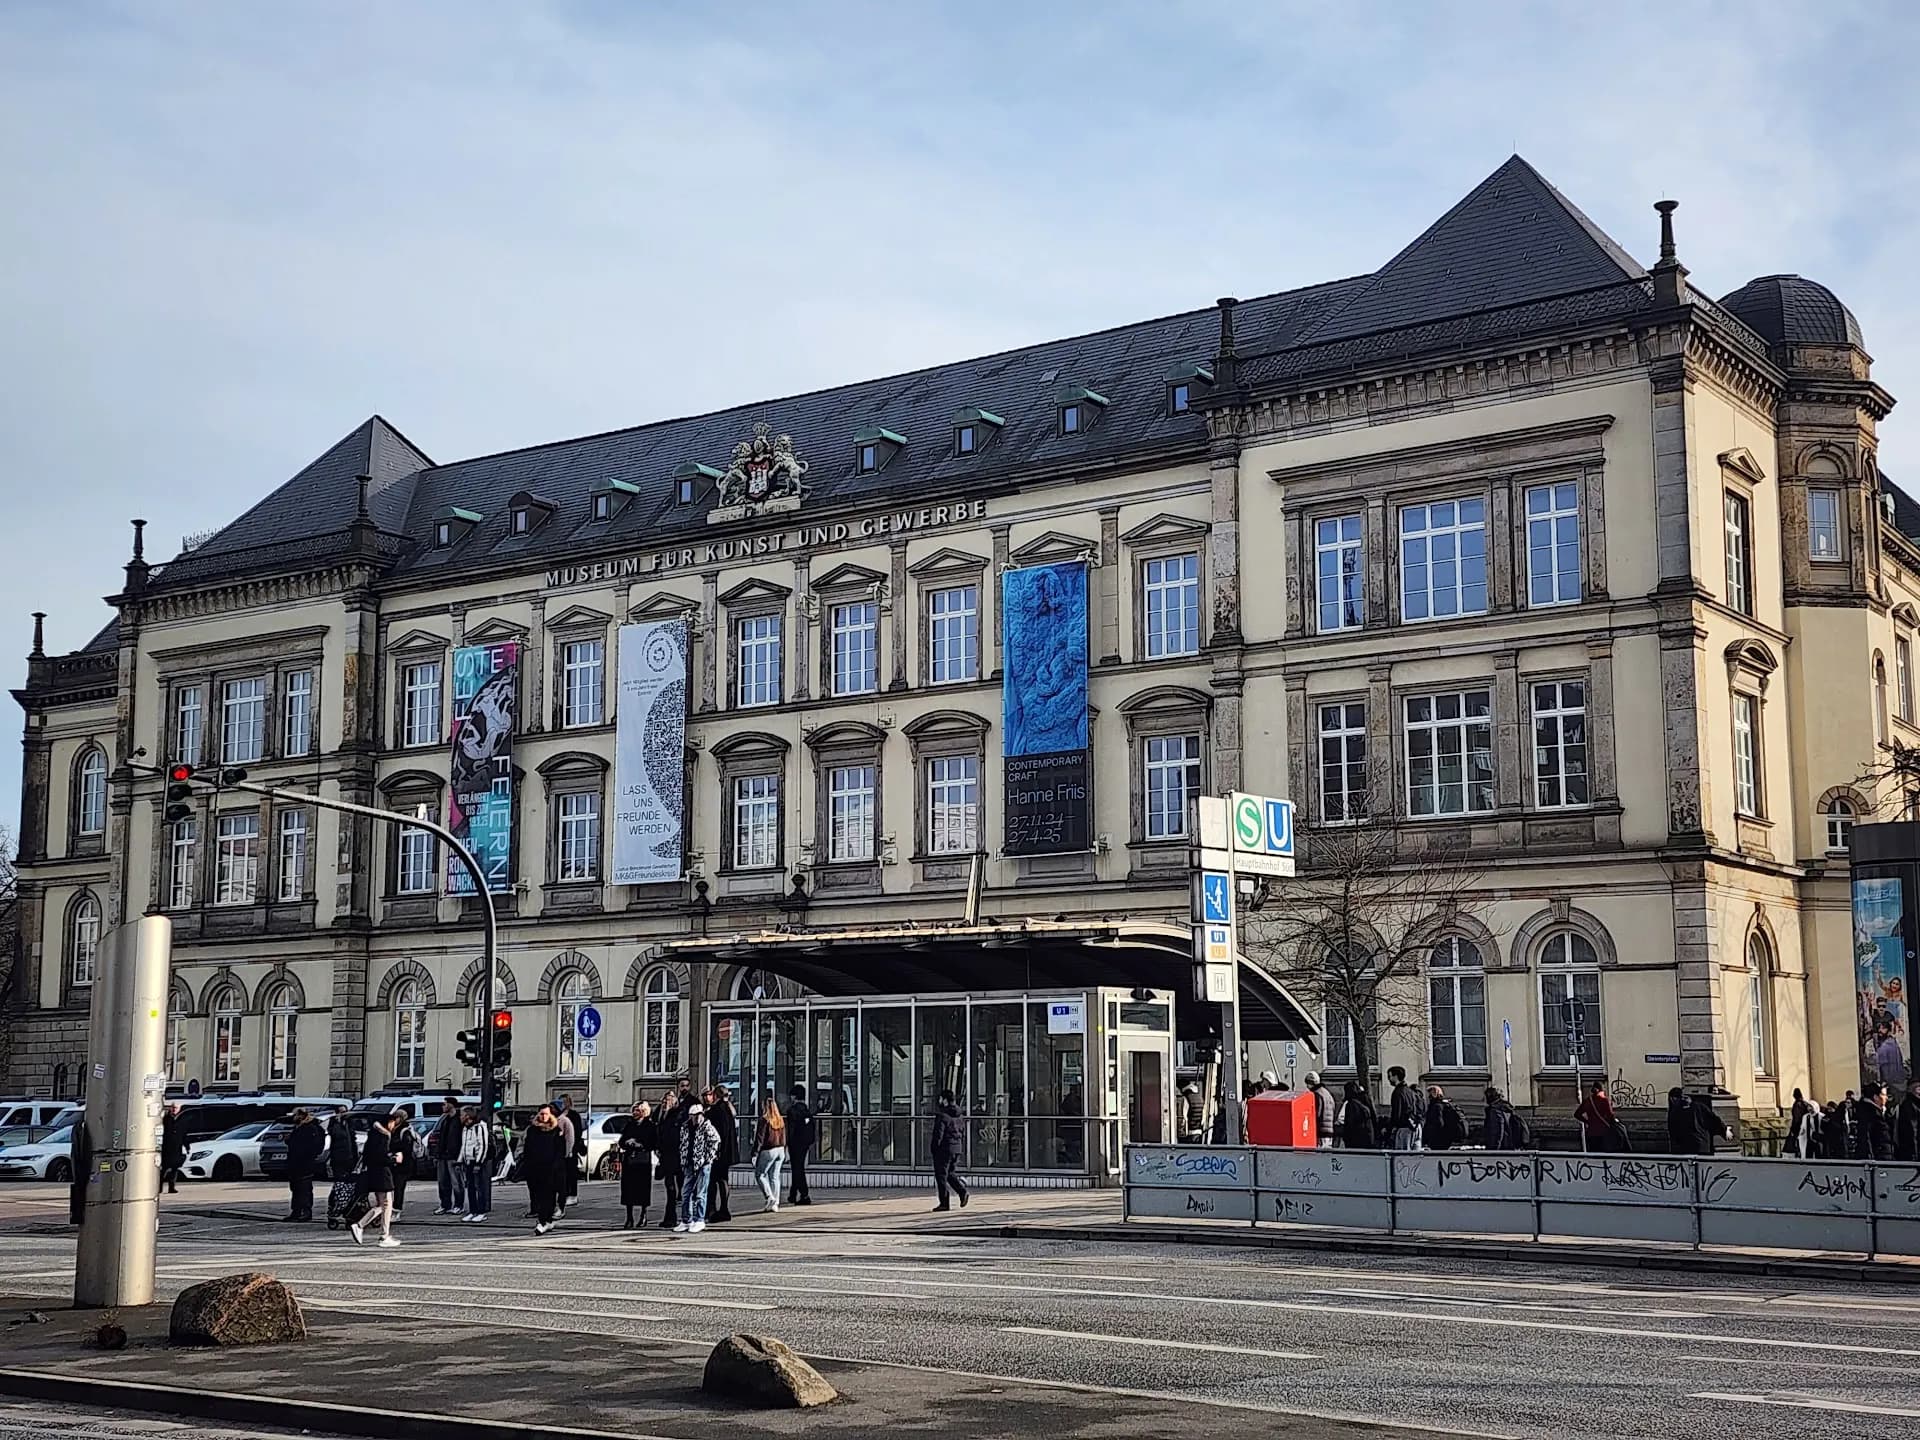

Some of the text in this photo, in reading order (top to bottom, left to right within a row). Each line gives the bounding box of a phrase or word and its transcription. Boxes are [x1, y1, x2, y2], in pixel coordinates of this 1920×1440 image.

[545, 500, 987, 587] MUSEUM FÜR KUNST UND GEWERBE
[1008, 756, 1083, 771] CONTEMPORARY
[1008, 771, 1038, 782] CRAFT
[623, 784, 647, 796] LASS
[1008, 783, 1085, 805] Hanne Friis
[633, 797, 653, 808] UNS
[616, 809, 661, 822] FREUNDE
[629, 823, 671, 835] WERDEN
[1238, 799, 1289, 848] S U
